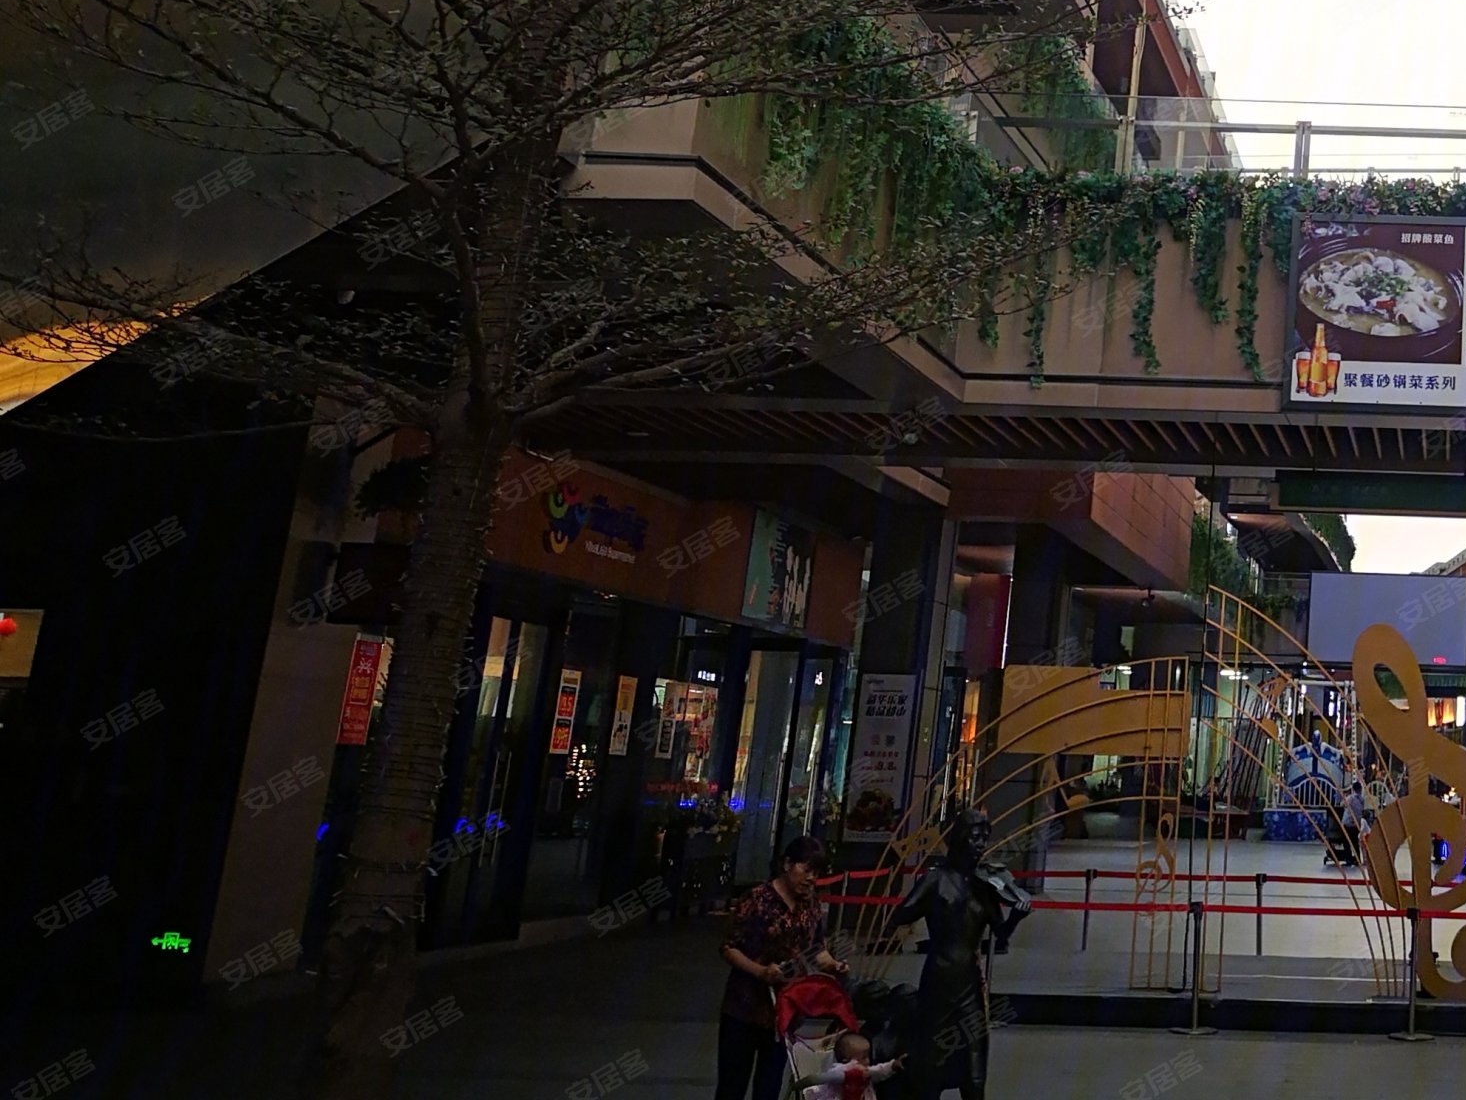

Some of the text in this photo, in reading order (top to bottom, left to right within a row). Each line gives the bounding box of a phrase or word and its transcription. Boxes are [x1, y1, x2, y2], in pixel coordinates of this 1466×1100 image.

[1401, 233, 1454, 245] 招牌酸菜鱼
[1344, 372, 1456, 391] 聚餐砂锅菜系列
